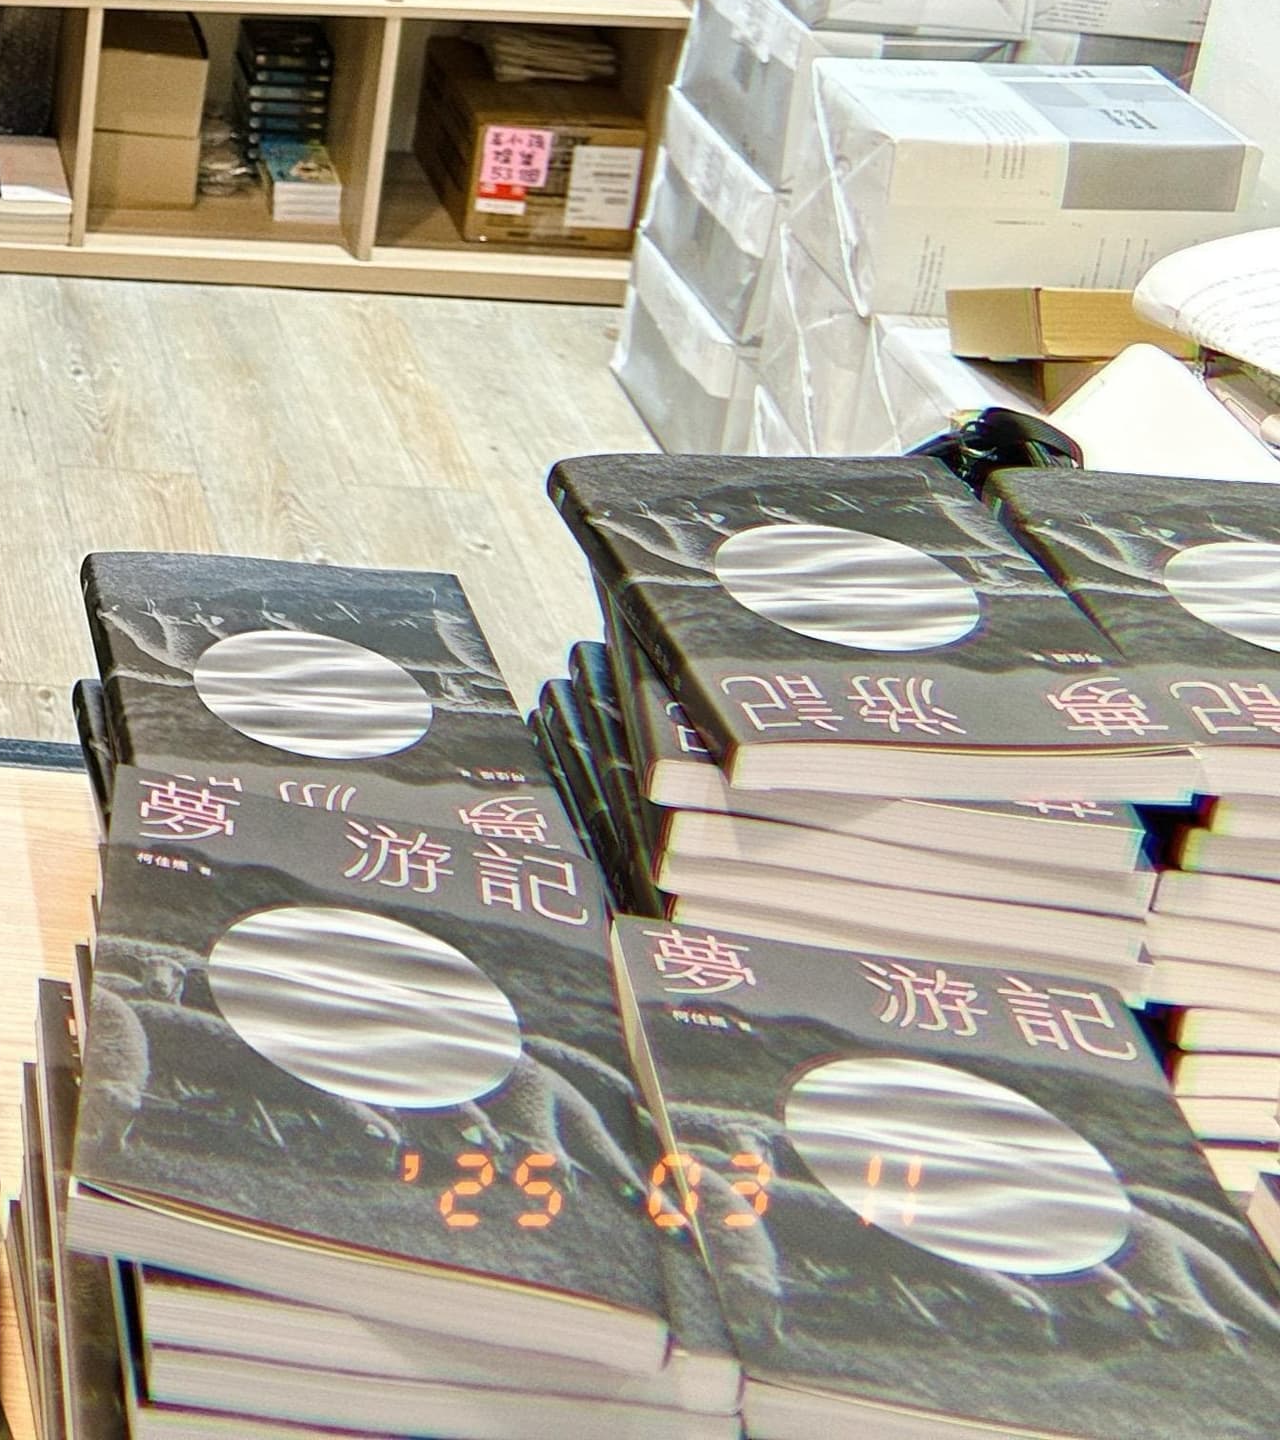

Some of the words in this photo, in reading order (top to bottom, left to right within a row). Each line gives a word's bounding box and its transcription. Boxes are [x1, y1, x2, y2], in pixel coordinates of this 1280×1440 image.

[721, 674, 967, 736] 游記
[1046, 676, 1169, 736] 夢
[344, 819, 589, 927] 游記
[642, 927, 756, 995] 夢
[859, 960, 1138, 1061] 游記
